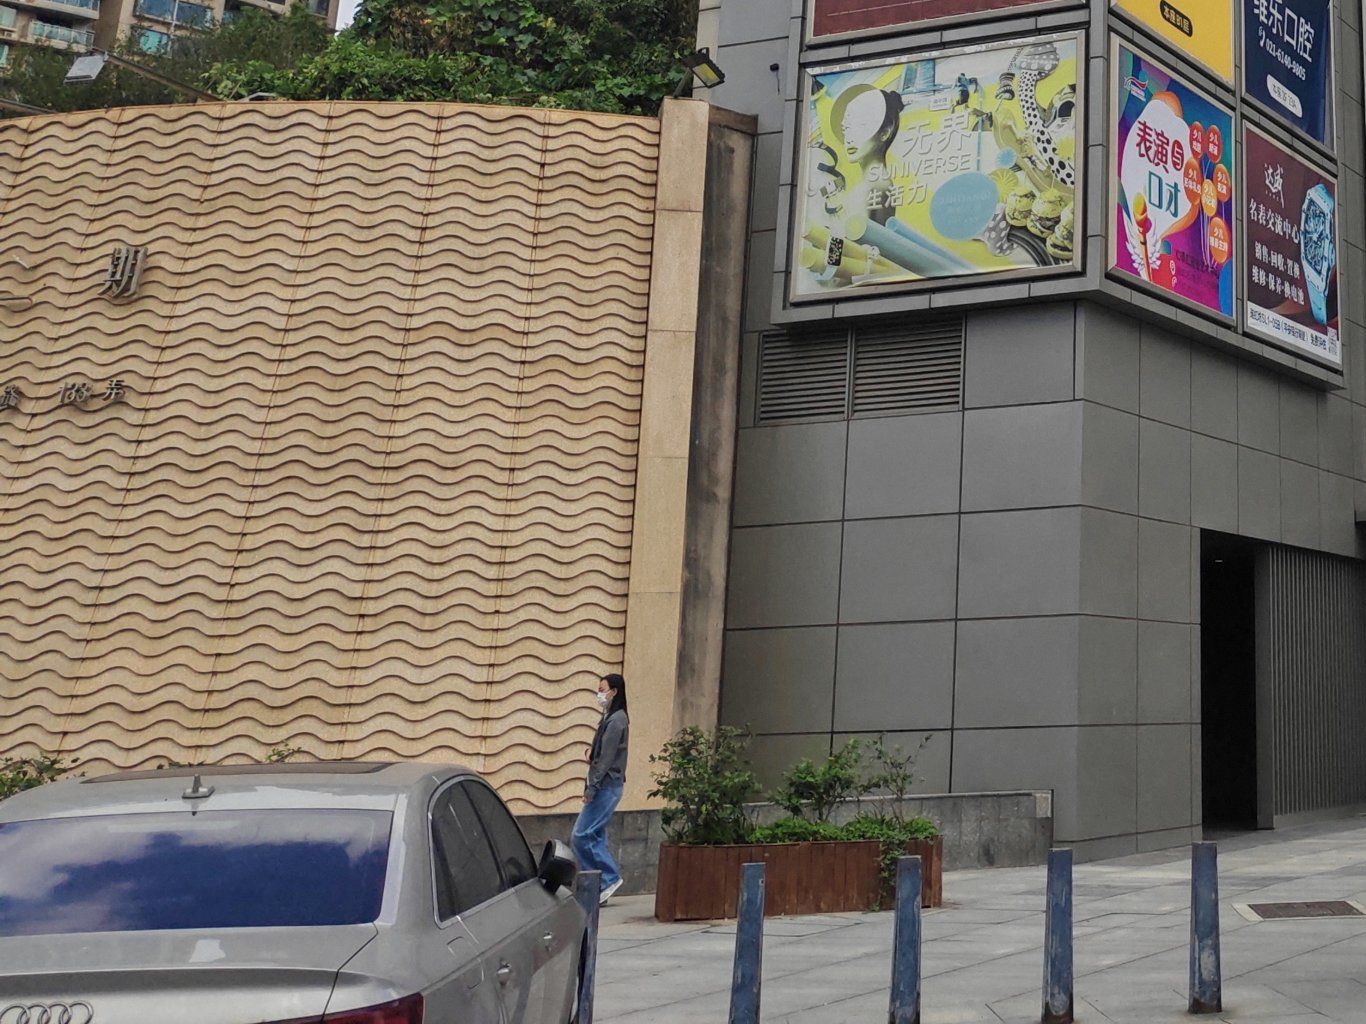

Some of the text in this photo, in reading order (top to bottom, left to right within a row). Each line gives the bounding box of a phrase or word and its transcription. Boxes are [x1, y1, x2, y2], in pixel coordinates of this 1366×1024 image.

[901, 110, 973, 159] 无界
[867, 152, 973, 183] SUNIVERSE
[865, 179, 929, 212] 生活力
[1148, 170, 1181, 219] 口才
[1249, 197, 1300, 245] 名表交流中心
